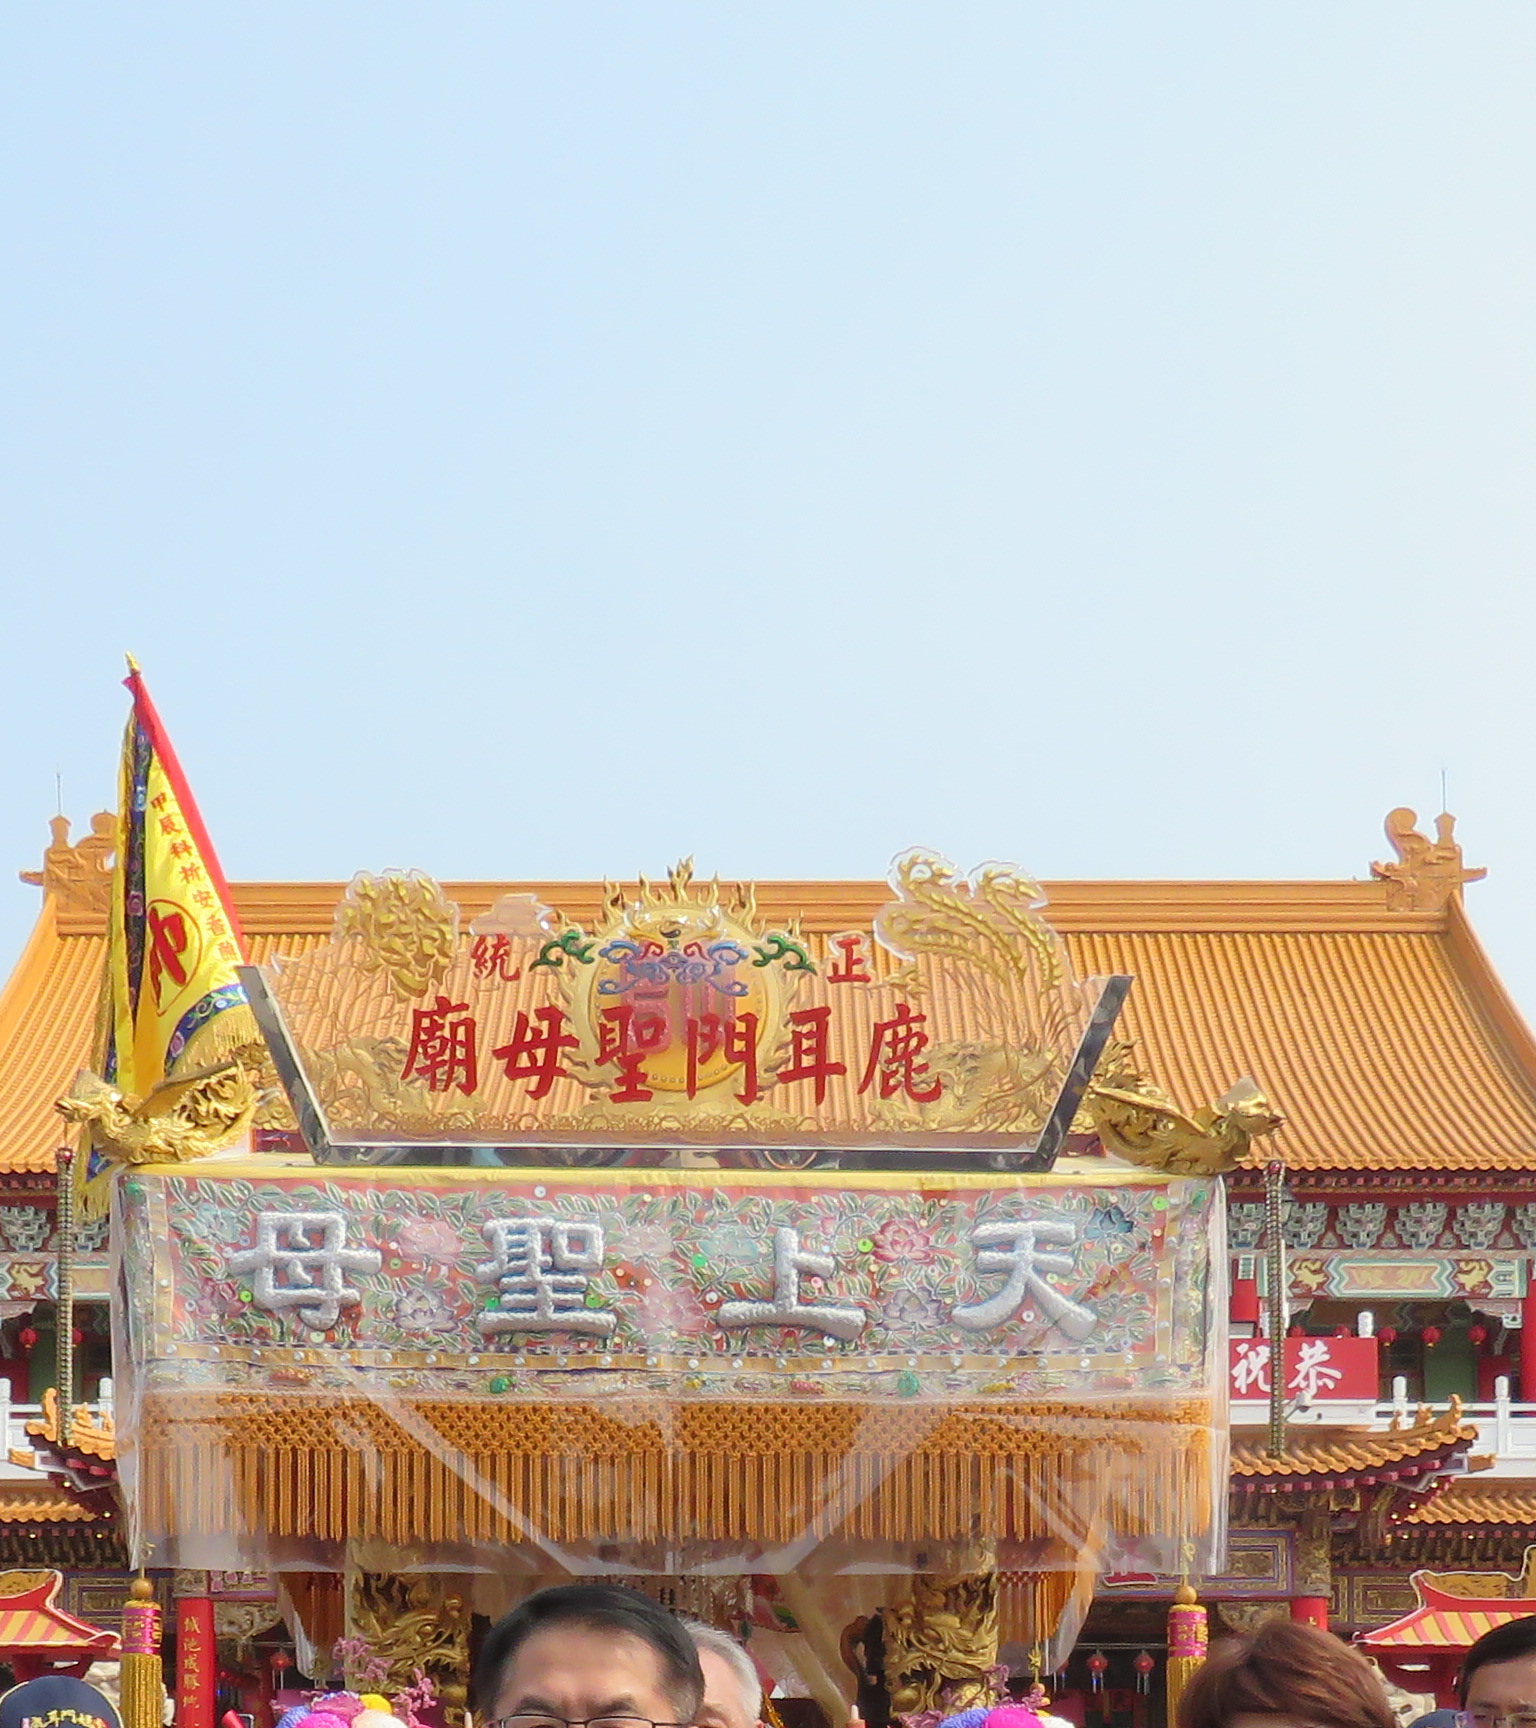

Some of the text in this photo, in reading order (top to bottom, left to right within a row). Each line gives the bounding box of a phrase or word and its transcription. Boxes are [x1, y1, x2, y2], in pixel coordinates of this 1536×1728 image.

[400, 997, 943, 1106] 鹿耳門聖母廟
[227, 1208, 1099, 1342] 天上聖母
[1230, 1339, 1343, 1396] 恭祝
